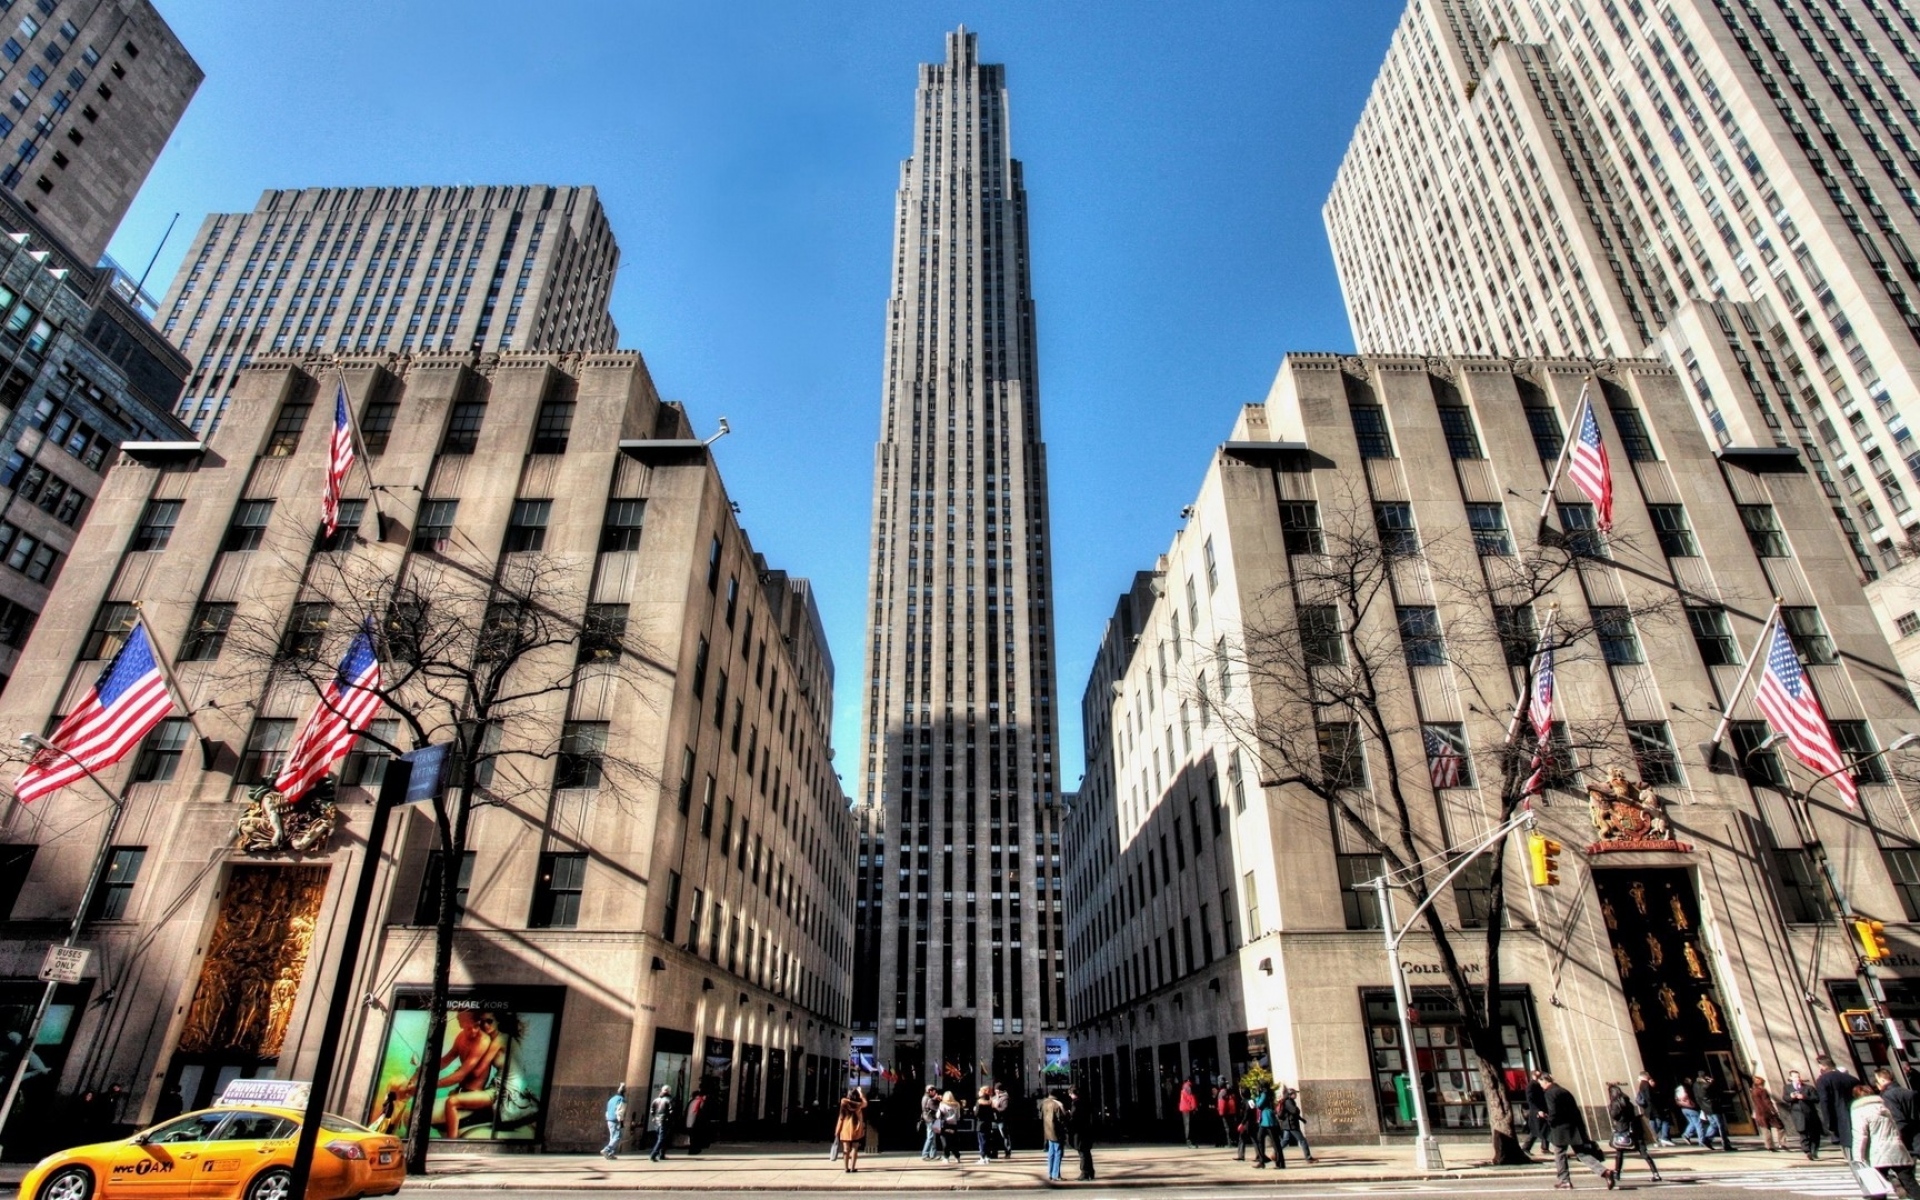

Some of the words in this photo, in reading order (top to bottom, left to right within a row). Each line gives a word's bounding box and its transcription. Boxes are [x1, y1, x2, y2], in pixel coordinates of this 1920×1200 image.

[57, 949, 82, 959] BUSES
[55, 960, 76, 970] ONLY
[483, 1001, 509, 1010] KORS
[229, 1081, 268, 1093] PRIVATE
[267, 1083, 292, 1094] EYES
[112, 1163, 135, 1174] NYC
[136, 1159, 174, 1175] TAXI
